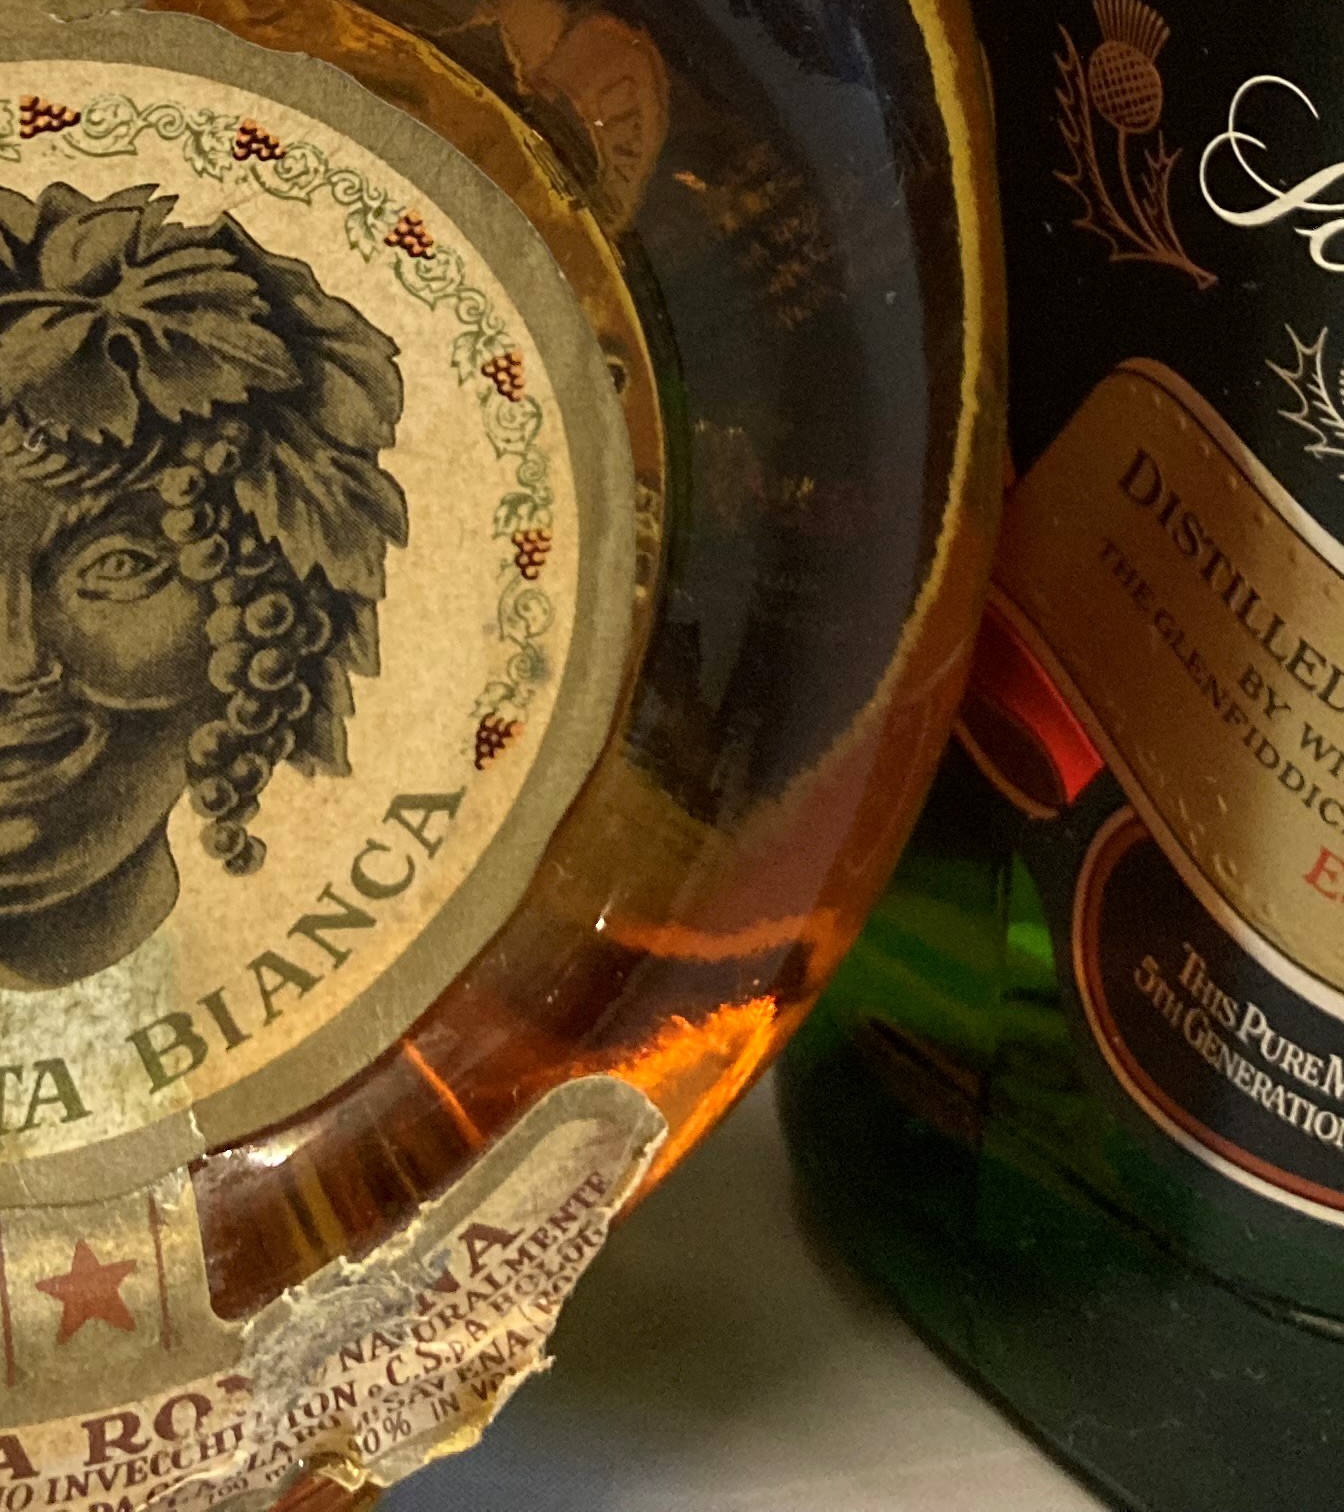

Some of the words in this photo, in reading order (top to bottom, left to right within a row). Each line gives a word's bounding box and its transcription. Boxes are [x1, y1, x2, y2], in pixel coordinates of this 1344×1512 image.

[1237, 662, 1292, 721] BY
[127, 785, 467, 1096] BIANCA
[1178, 941, 1240, 1031] THIS
[1236, 1001, 1325, 1089] PURE
